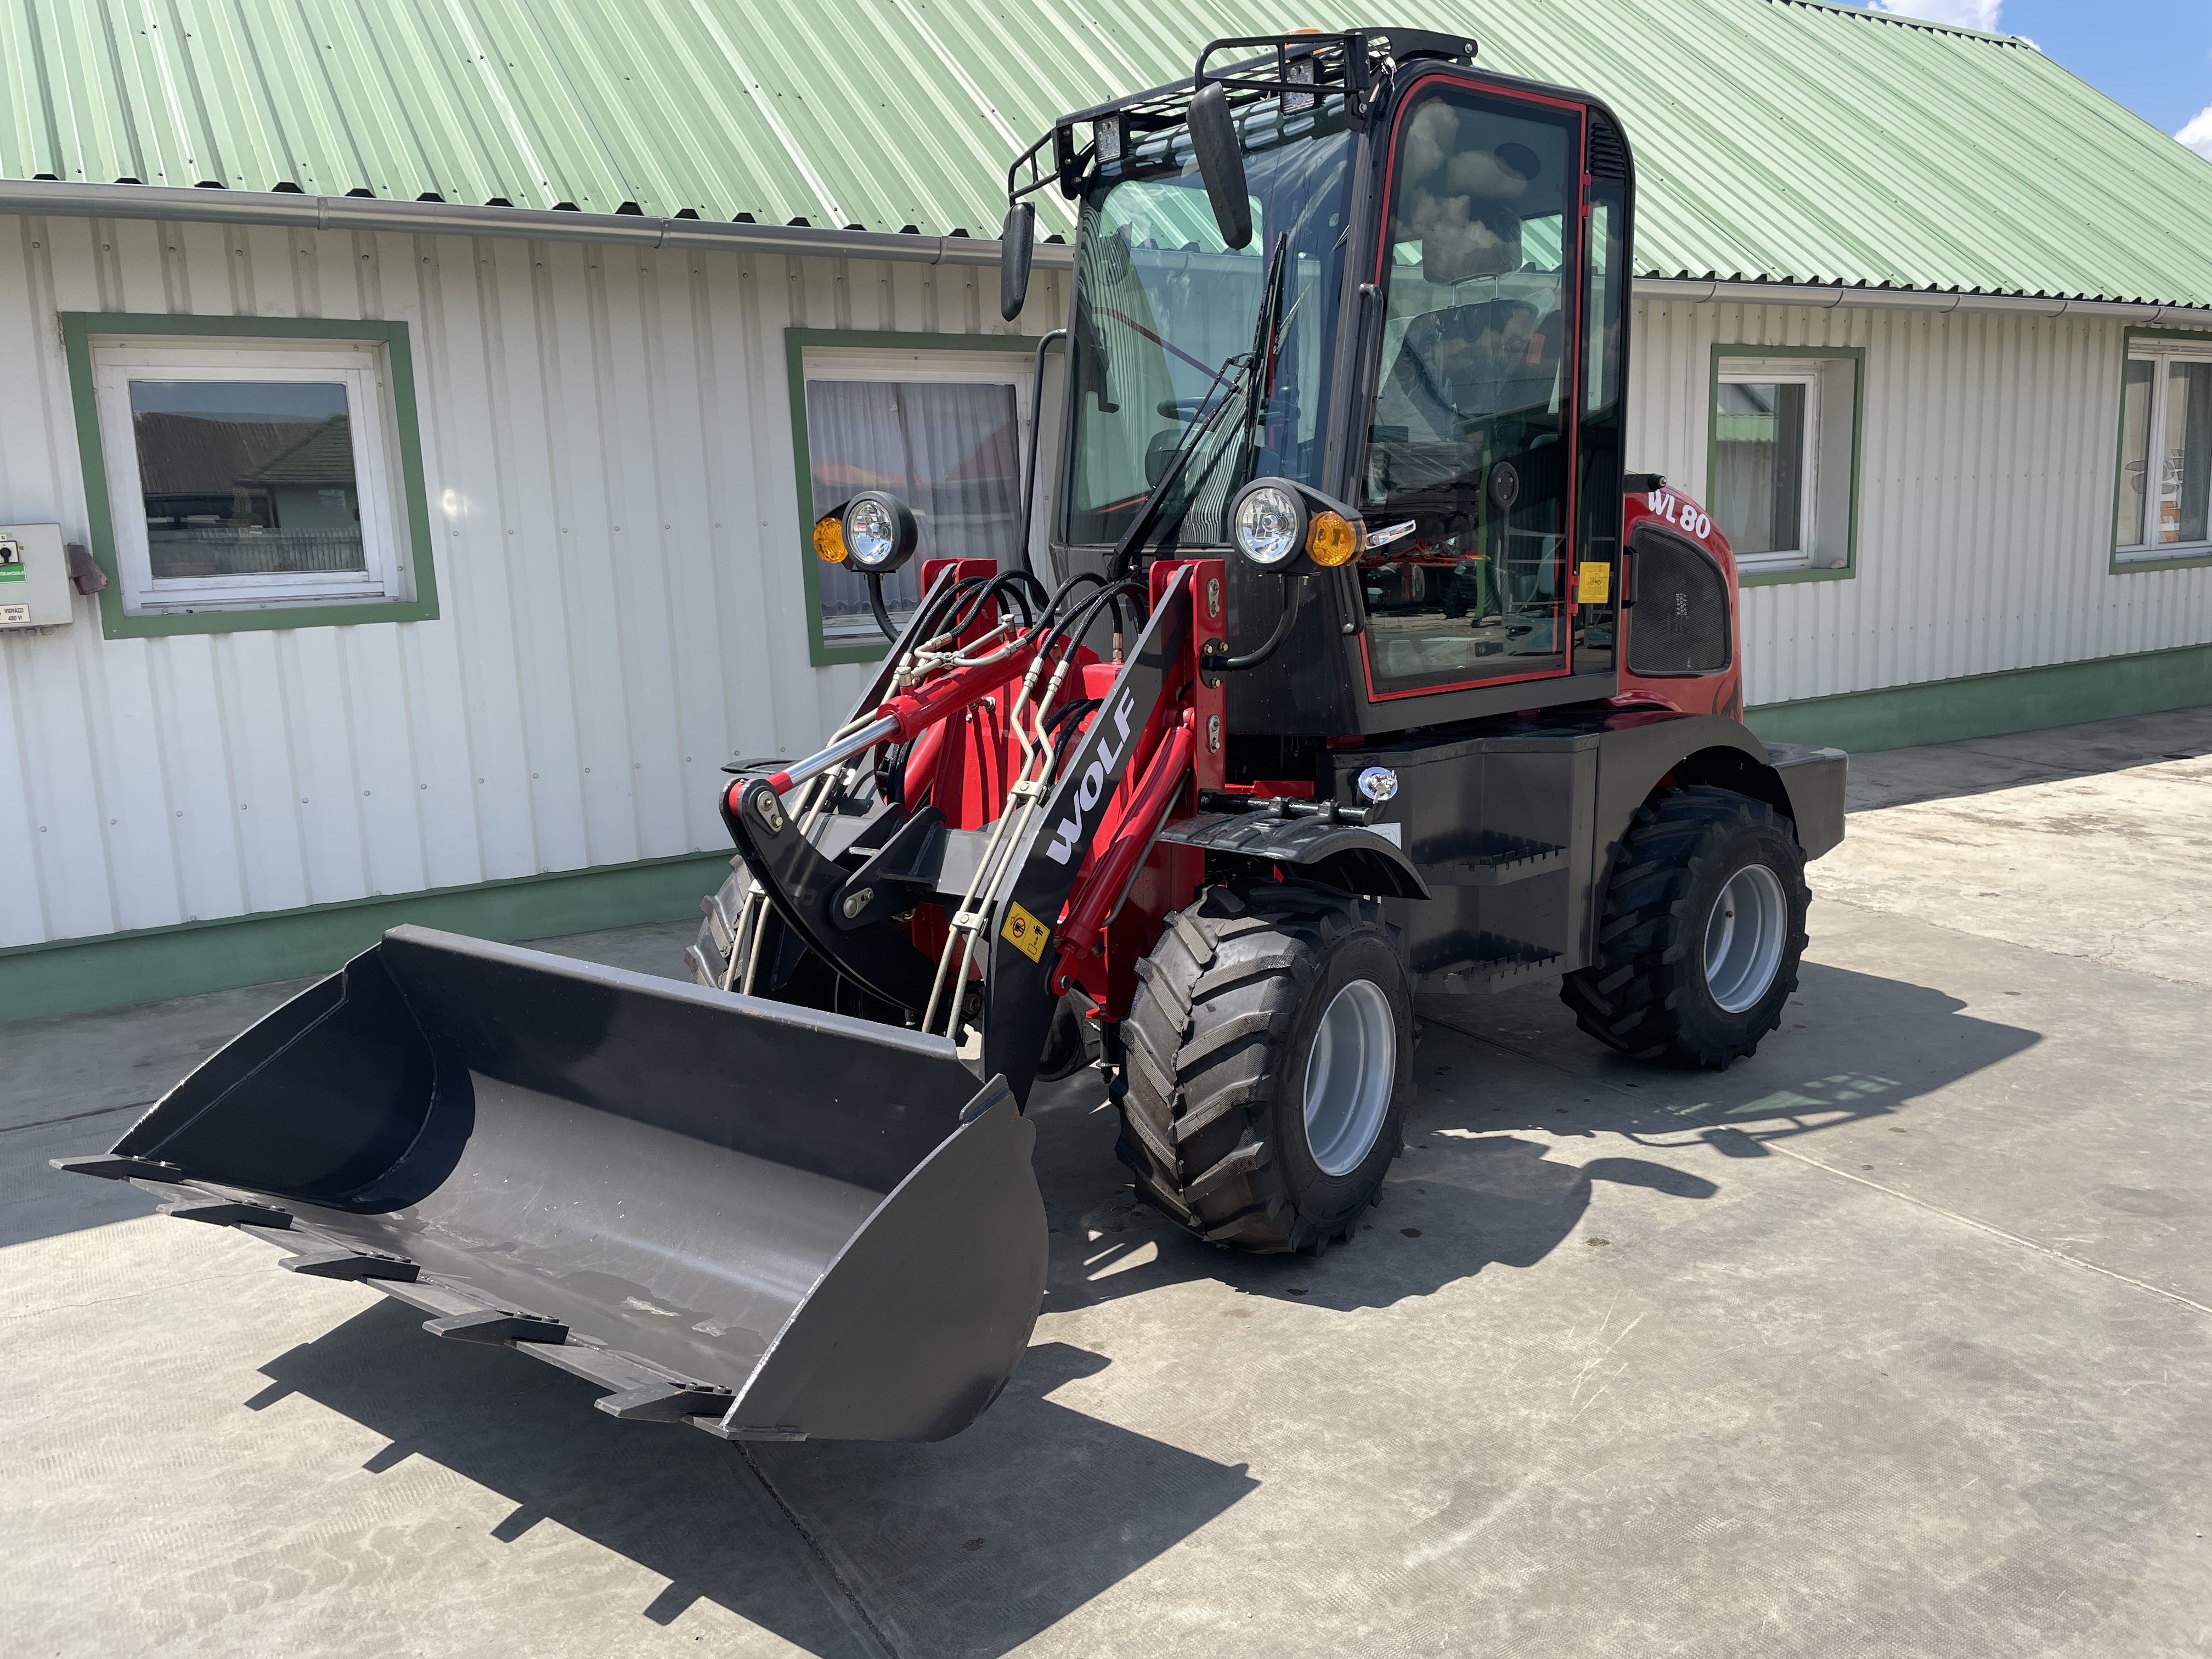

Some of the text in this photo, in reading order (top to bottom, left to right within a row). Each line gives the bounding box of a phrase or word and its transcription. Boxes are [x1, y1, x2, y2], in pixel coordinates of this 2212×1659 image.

[1648, 489, 1711, 539] WL 80
[1046, 686, 1134, 865] WOLF
